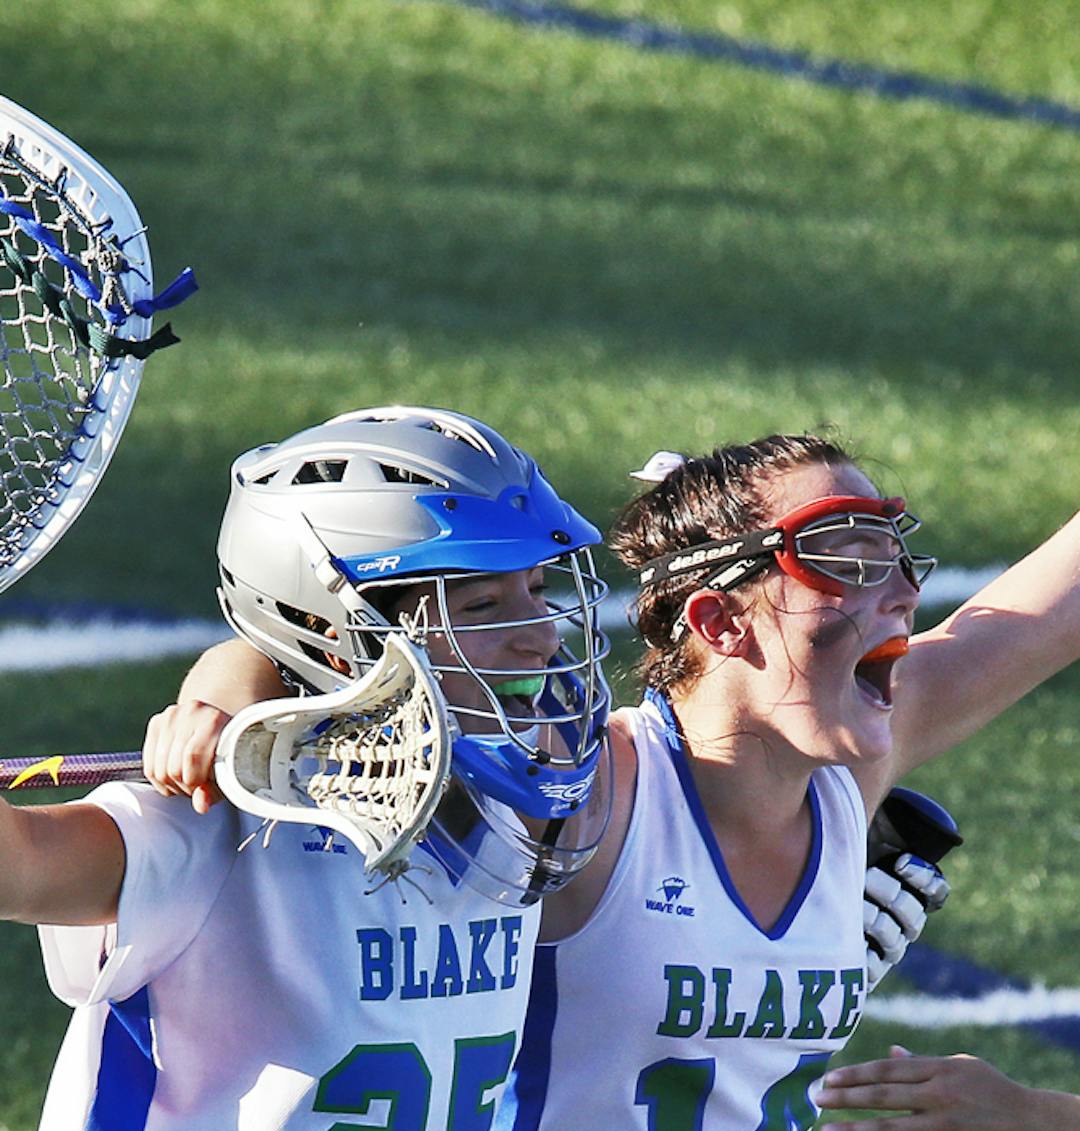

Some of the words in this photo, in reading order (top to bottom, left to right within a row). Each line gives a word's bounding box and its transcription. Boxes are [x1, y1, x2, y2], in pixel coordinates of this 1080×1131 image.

[668, 541, 744, 572] deBeer
[302, 841, 331, 853] WAV
[645, 899, 674, 914] WAVE
[676, 904, 696, 917] ONE
[356, 916, 522, 1002] BLAKE
[656, 964, 865, 1040] BLAKE
